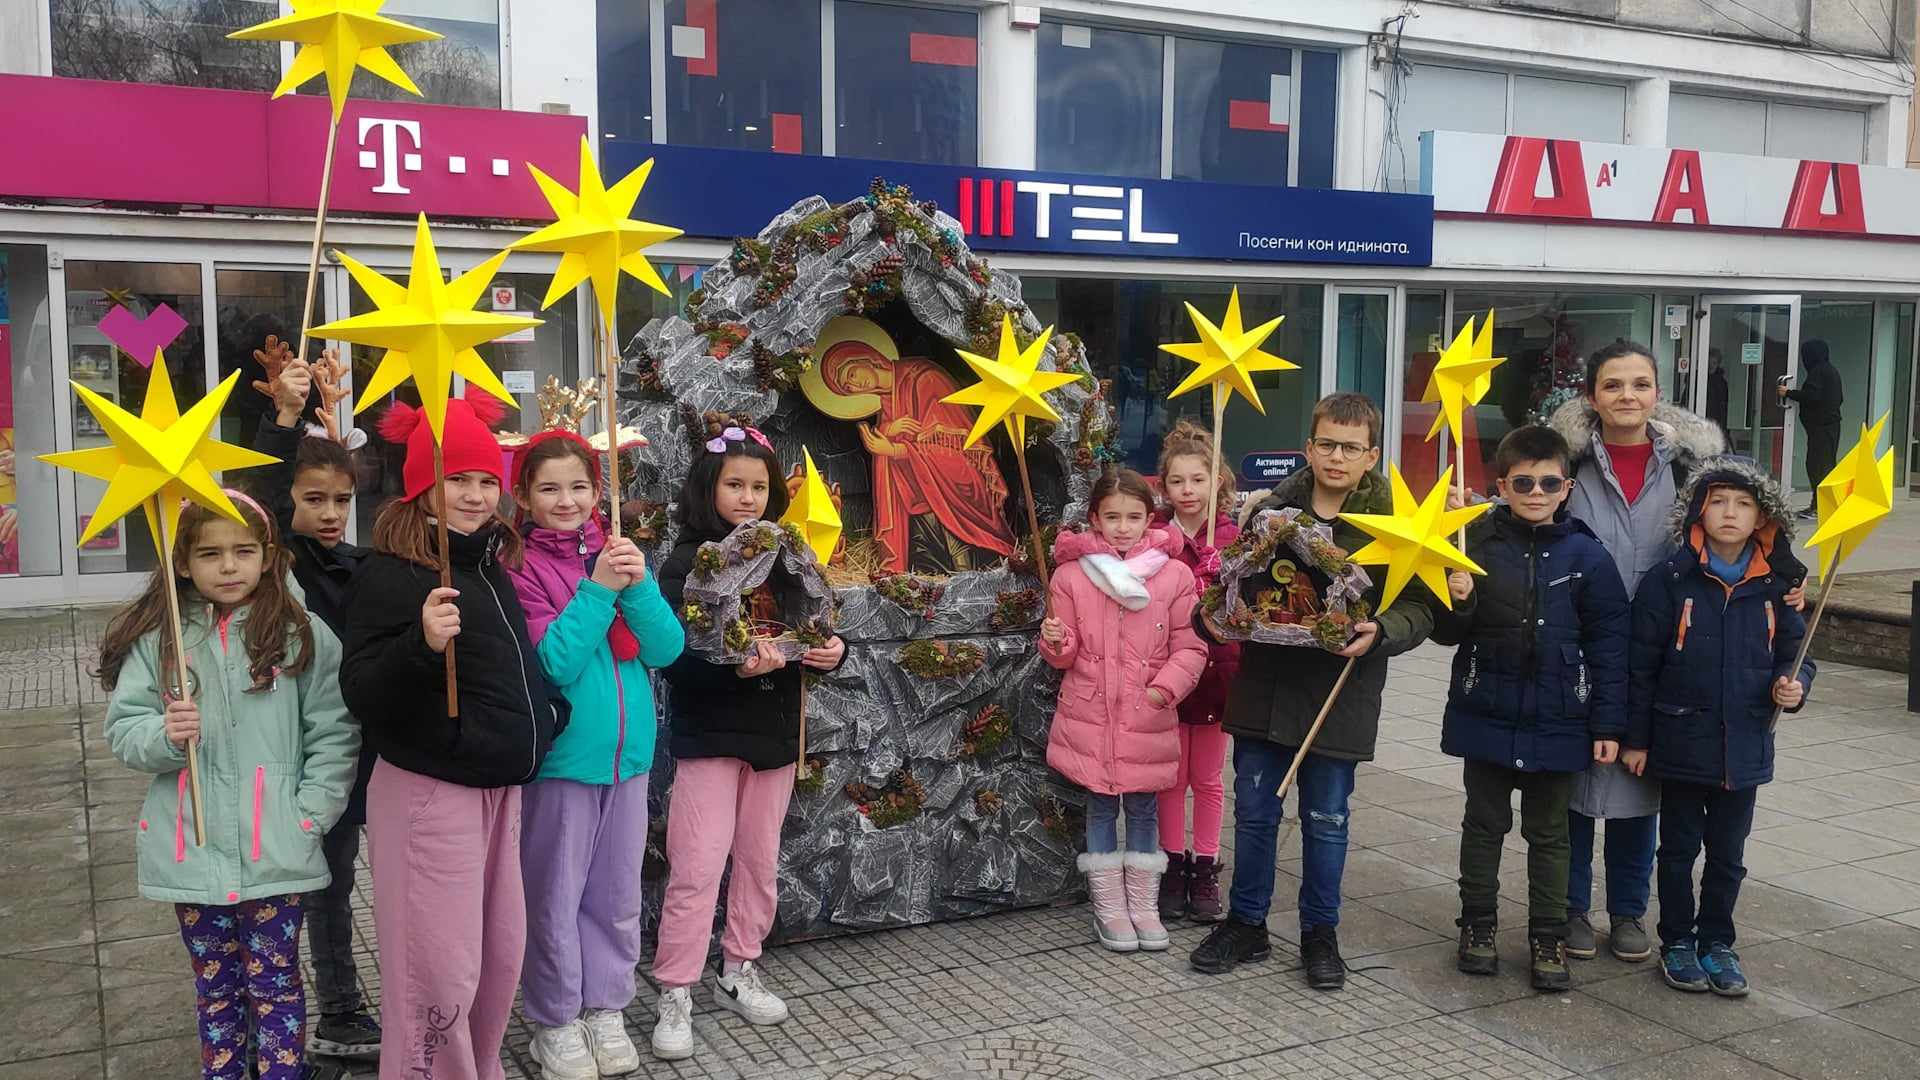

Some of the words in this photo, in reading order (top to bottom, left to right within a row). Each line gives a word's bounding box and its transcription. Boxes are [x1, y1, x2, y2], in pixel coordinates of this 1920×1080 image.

[1596, 159, 1618, 188] A1
[1239, 231, 1304, 250] Посегни
[1307, 238, 1335, 251] кон
[1338, 240, 1411, 254] иднината.
[1255, 456, 1296, 468] Активирај
[1262, 467, 1289, 476] online!
